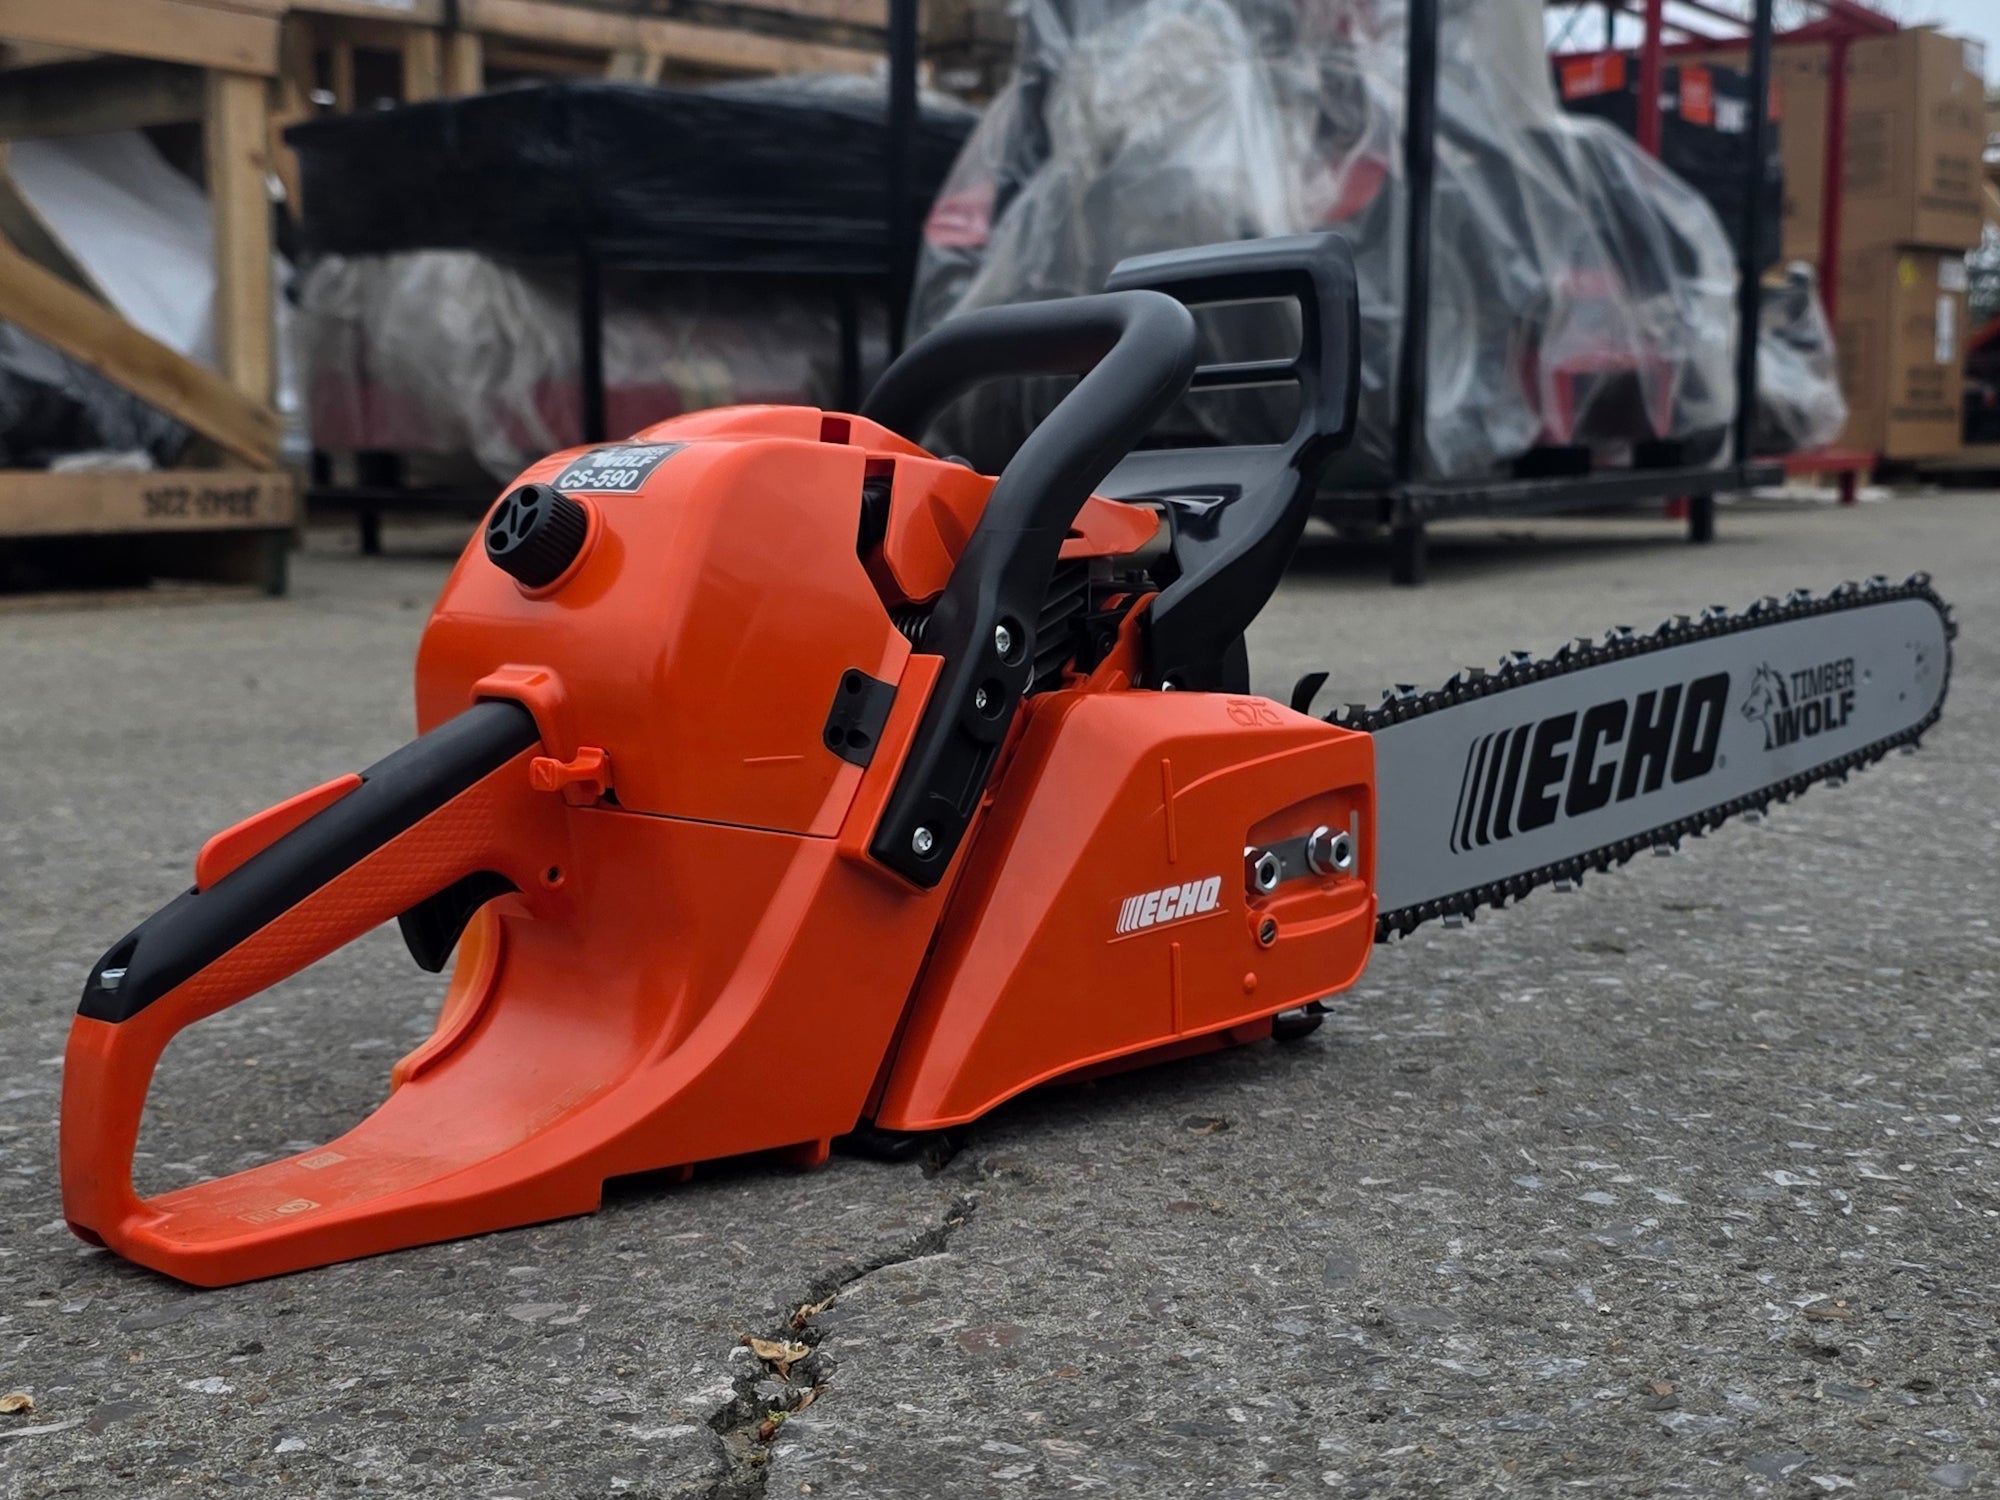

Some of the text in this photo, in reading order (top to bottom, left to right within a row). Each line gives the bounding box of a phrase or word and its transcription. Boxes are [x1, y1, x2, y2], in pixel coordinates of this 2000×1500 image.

[560, 469, 639, 488] CS-590
[1790, 657, 1854, 702] TIMBER
[1773, 690, 1855, 747] WOLF
[1516, 671, 1731, 833] ECHO
[1138, 876, 1222, 928] ECHO
